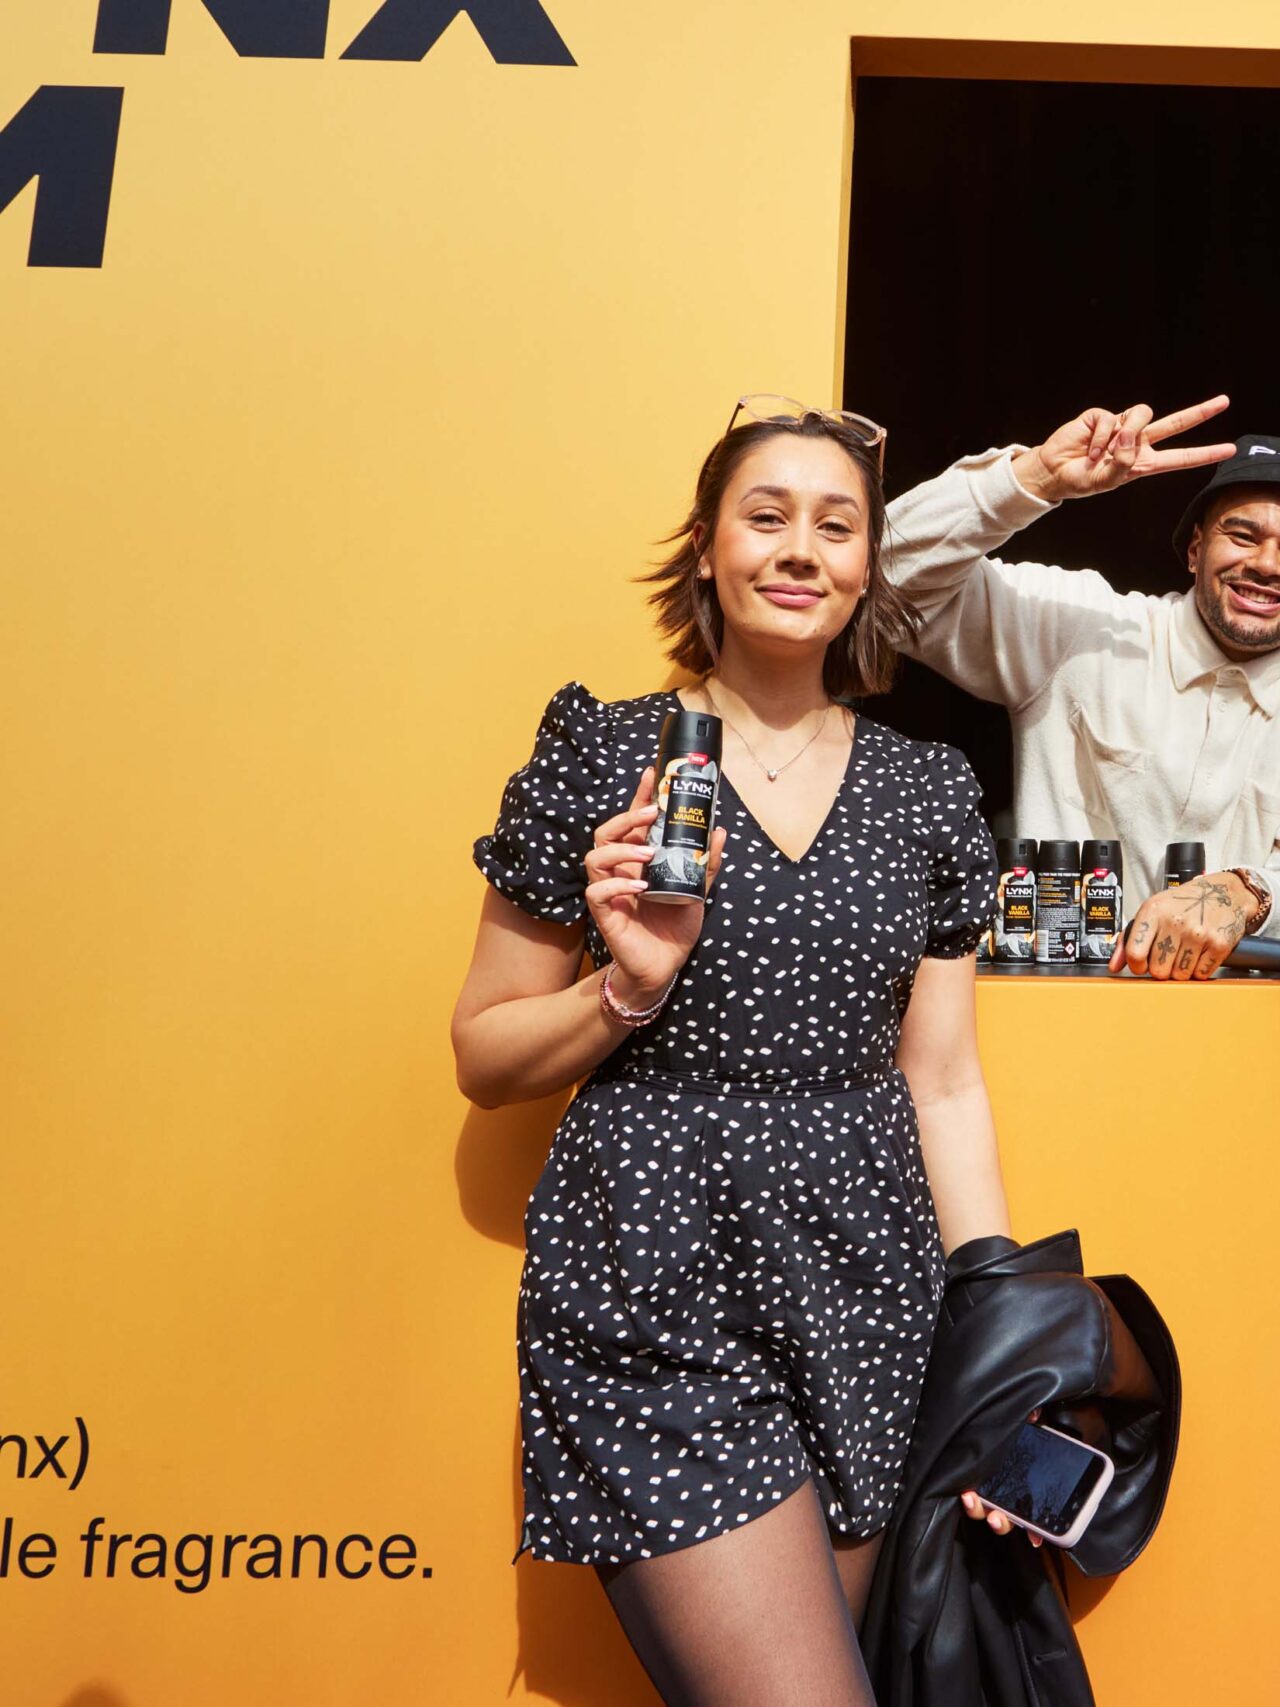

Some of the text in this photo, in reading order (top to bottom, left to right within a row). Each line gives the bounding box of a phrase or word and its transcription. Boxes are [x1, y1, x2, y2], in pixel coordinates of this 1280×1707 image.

[674, 780, 712, 795] LYNX
[678, 805, 704, 817] BLACK
[673, 812, 706, 825] VANILLA
[1006, 887, 1033, 896] LYNX
[1087, 888, 1114, 897] LYNX
[0, 1517, 434, 1595] le fragrance.
